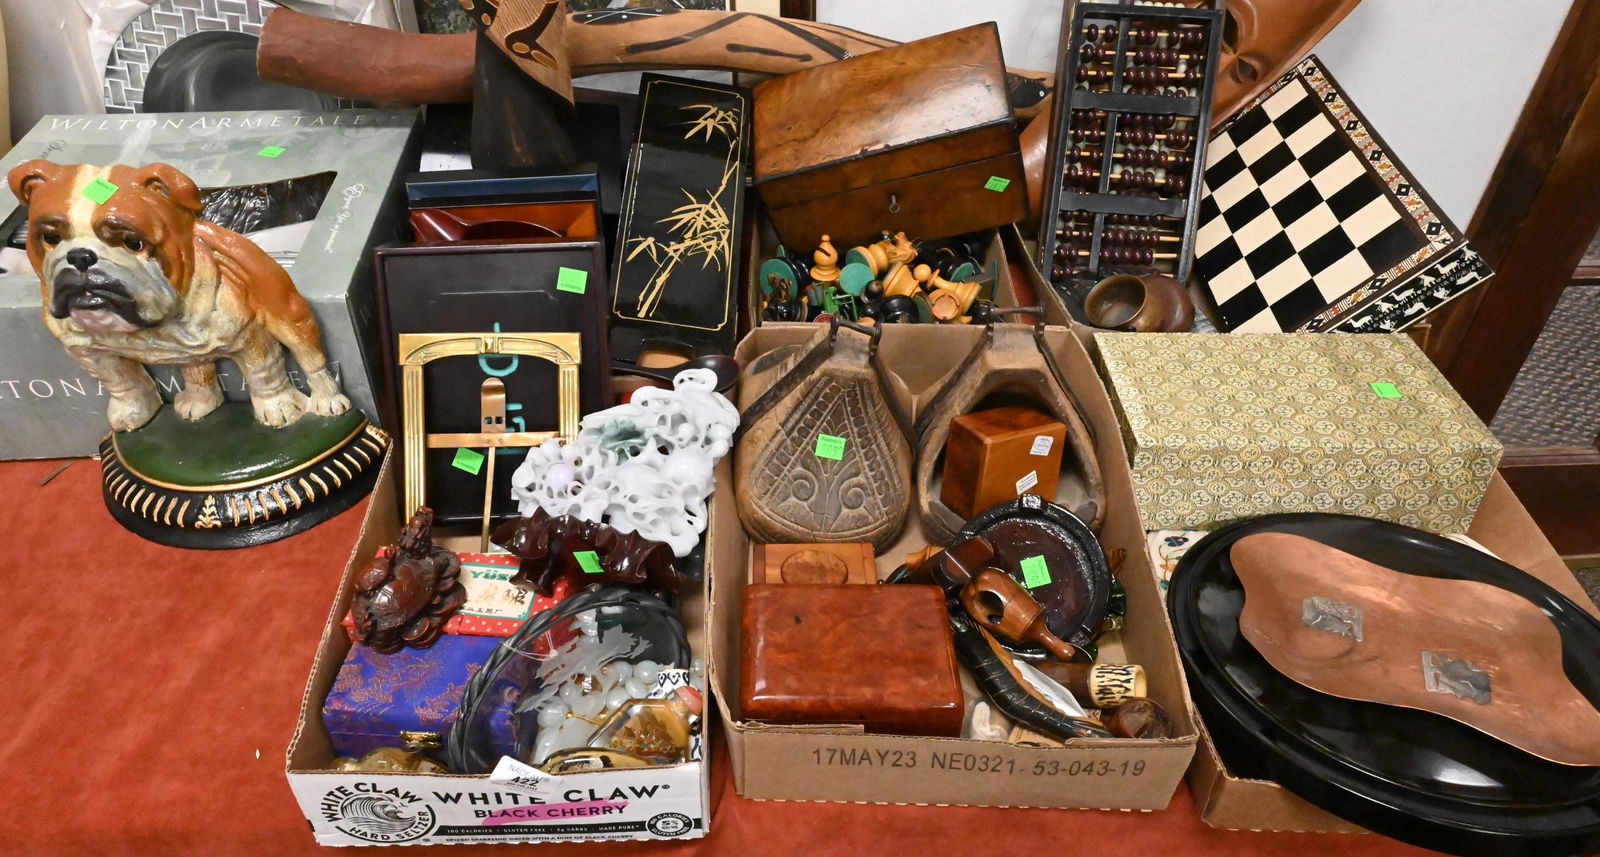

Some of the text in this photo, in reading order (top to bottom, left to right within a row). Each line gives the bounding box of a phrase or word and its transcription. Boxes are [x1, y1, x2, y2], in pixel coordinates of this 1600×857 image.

[812, 748, 917, 769] 17MAY23
[1032, 759, 1146, 777] 53-043-19
[511, 776, 539, 787] 422
[321, 782, 423, 822] WHITE CLAW
[432, 790, 546, 805] WHITE
[474, 805, 628, 818] BLACK CHERRY
[349, 811, 430, 841] HARD SELTZER
